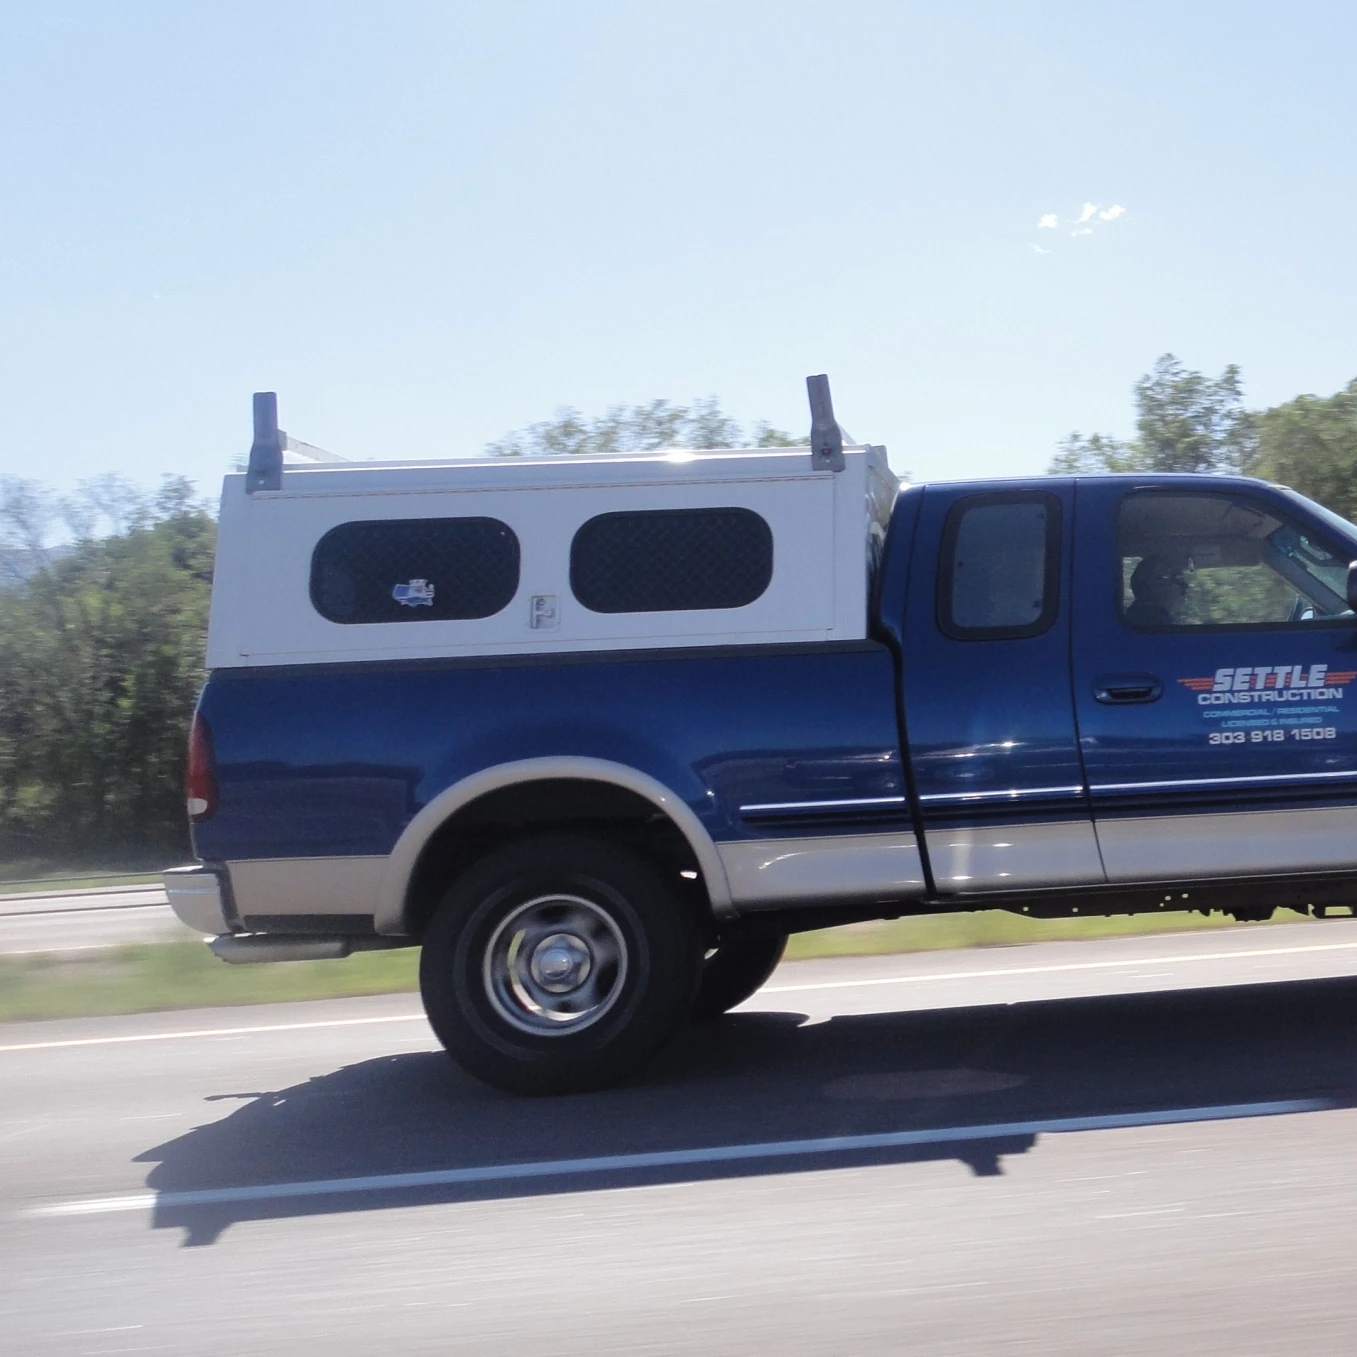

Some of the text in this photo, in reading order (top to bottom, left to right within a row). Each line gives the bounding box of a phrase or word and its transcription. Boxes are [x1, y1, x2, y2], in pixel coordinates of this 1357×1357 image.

[1212, 664, 1328, 691] SETTLE
[1198, 688, 1343, 705] CONSTRUCTION
[1203, 708, 1270, 718] COMMERCIAL
[1277, 706, 1340, 716] RESIDENTIAL
[1221, 716, 1323, 728] LICENSED & INSURED
[1209, 727, 1337, 745] 303 918 1508
